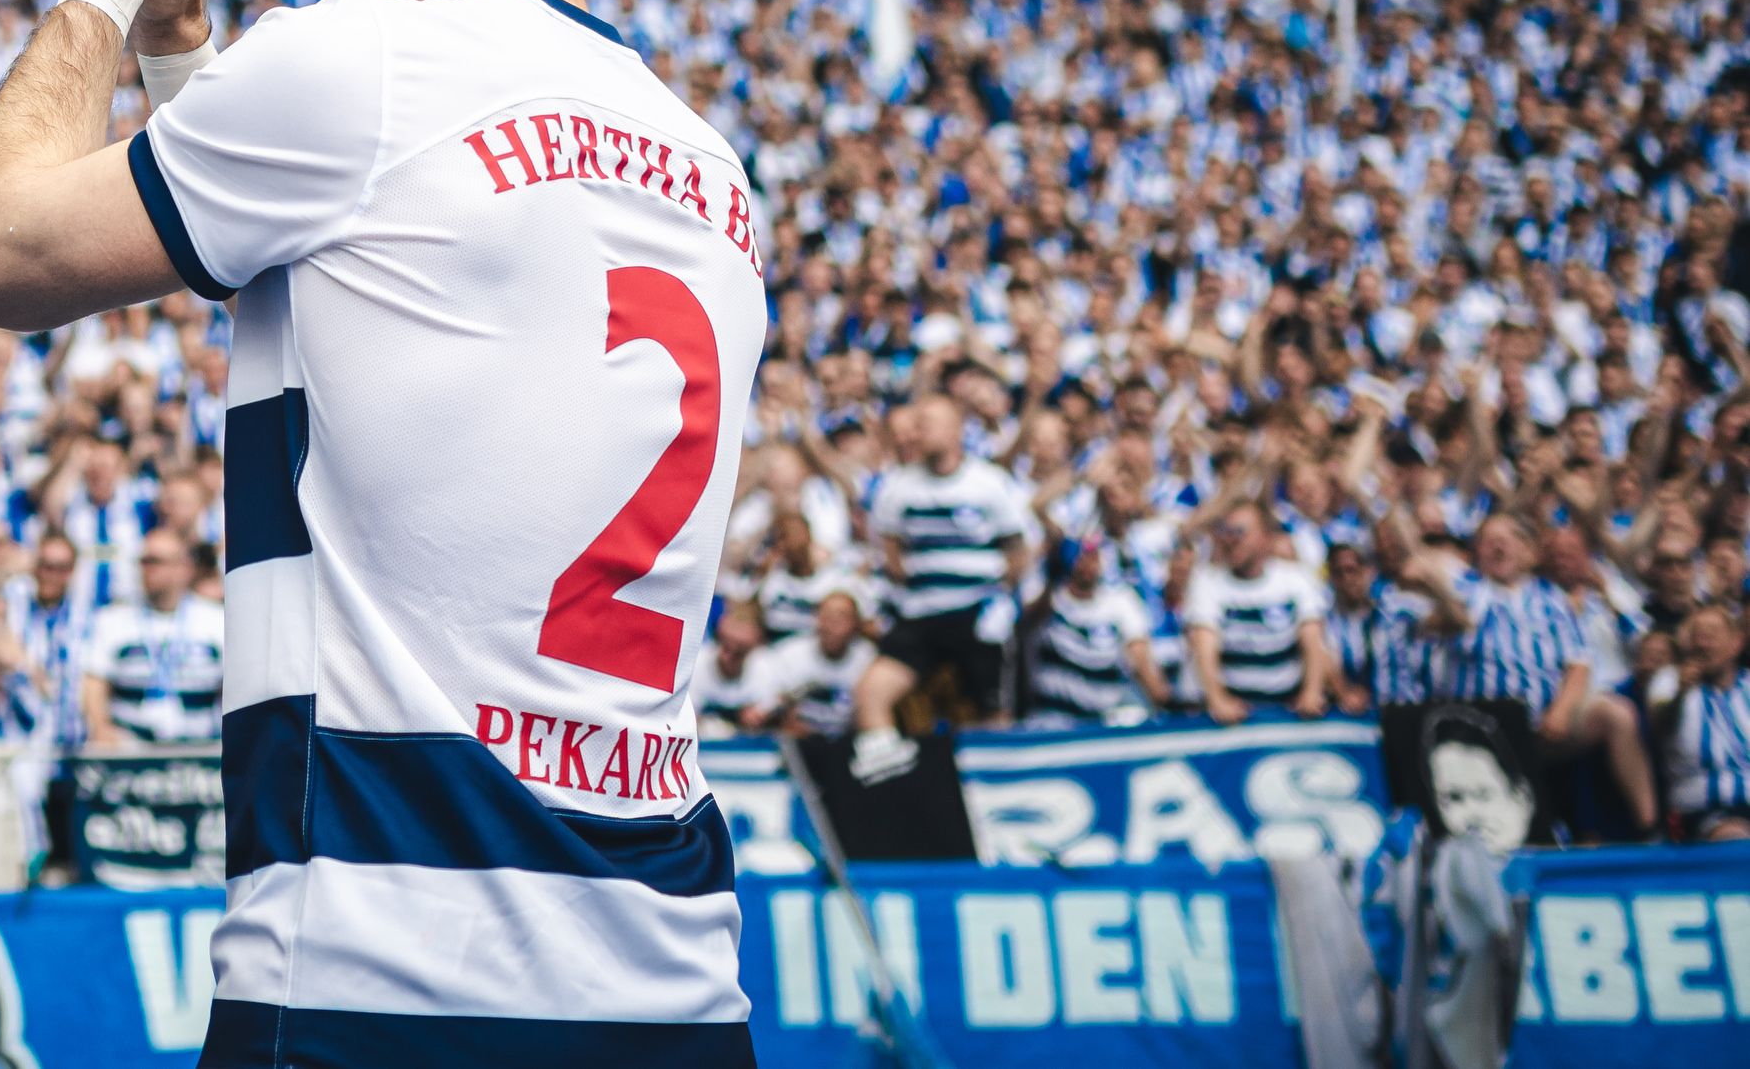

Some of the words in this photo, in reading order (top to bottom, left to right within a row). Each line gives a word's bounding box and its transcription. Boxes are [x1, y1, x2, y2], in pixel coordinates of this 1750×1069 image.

[463, 113, 712, 223] HERTHA
[538, 266, 721, 693] 2
[769, 888, 925, 1027] IN
[955, 889, 1238, 1029] DEN
